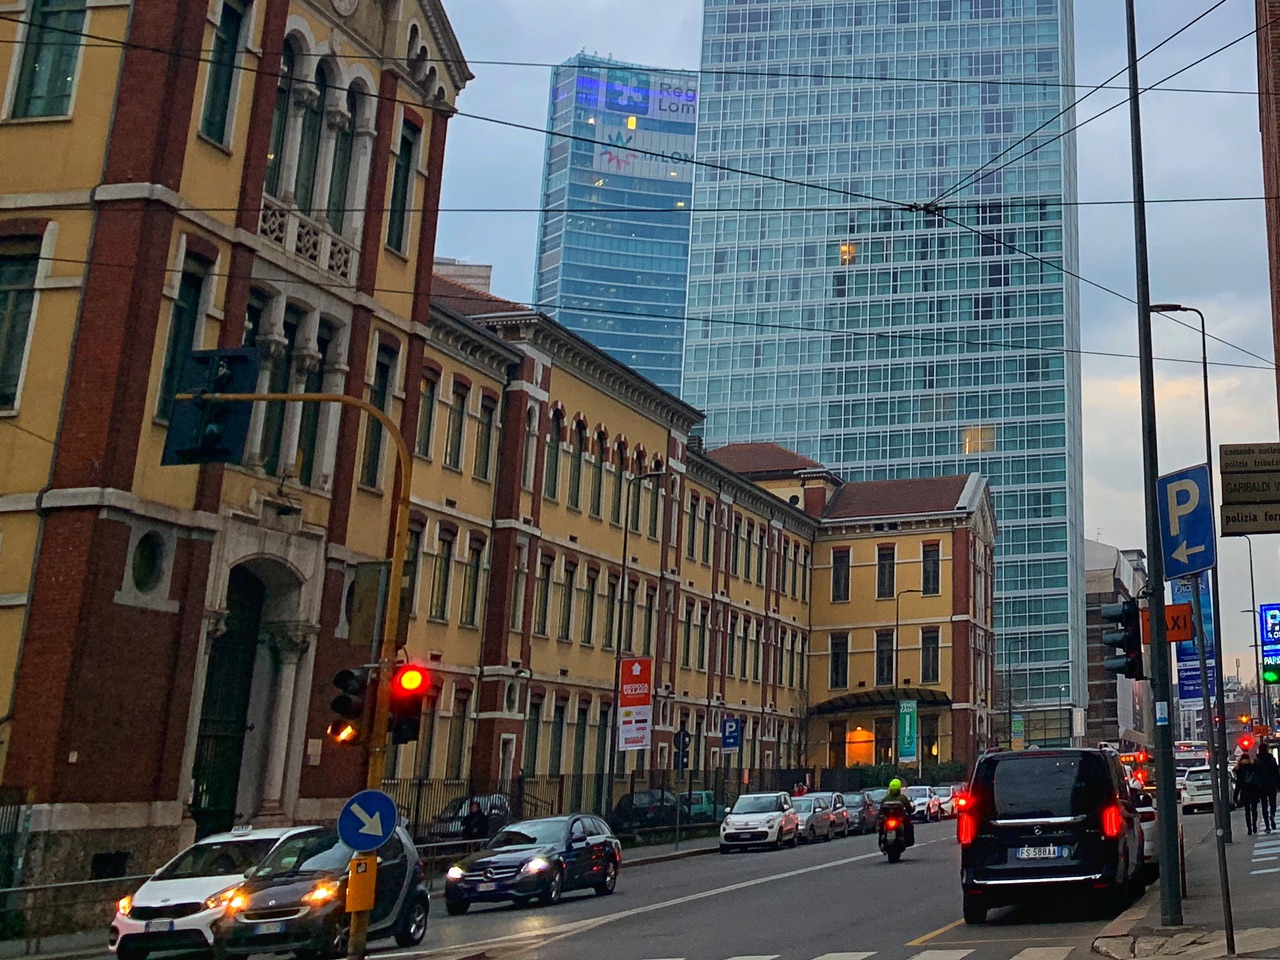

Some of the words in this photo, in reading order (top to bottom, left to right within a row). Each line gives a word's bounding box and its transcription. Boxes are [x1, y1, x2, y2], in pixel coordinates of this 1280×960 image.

[658, 98, 696, 114] Lom
[1258, 446, 1280, 454] nucleo
[1224, 460, 1248, 469] polizia
[1226, 482, 1270, 493] GARIBALDI
[1166, 478, 1200, 537] P
[1225, 513, 1258, 524] polizia
[726, 722, 736, 736] P
